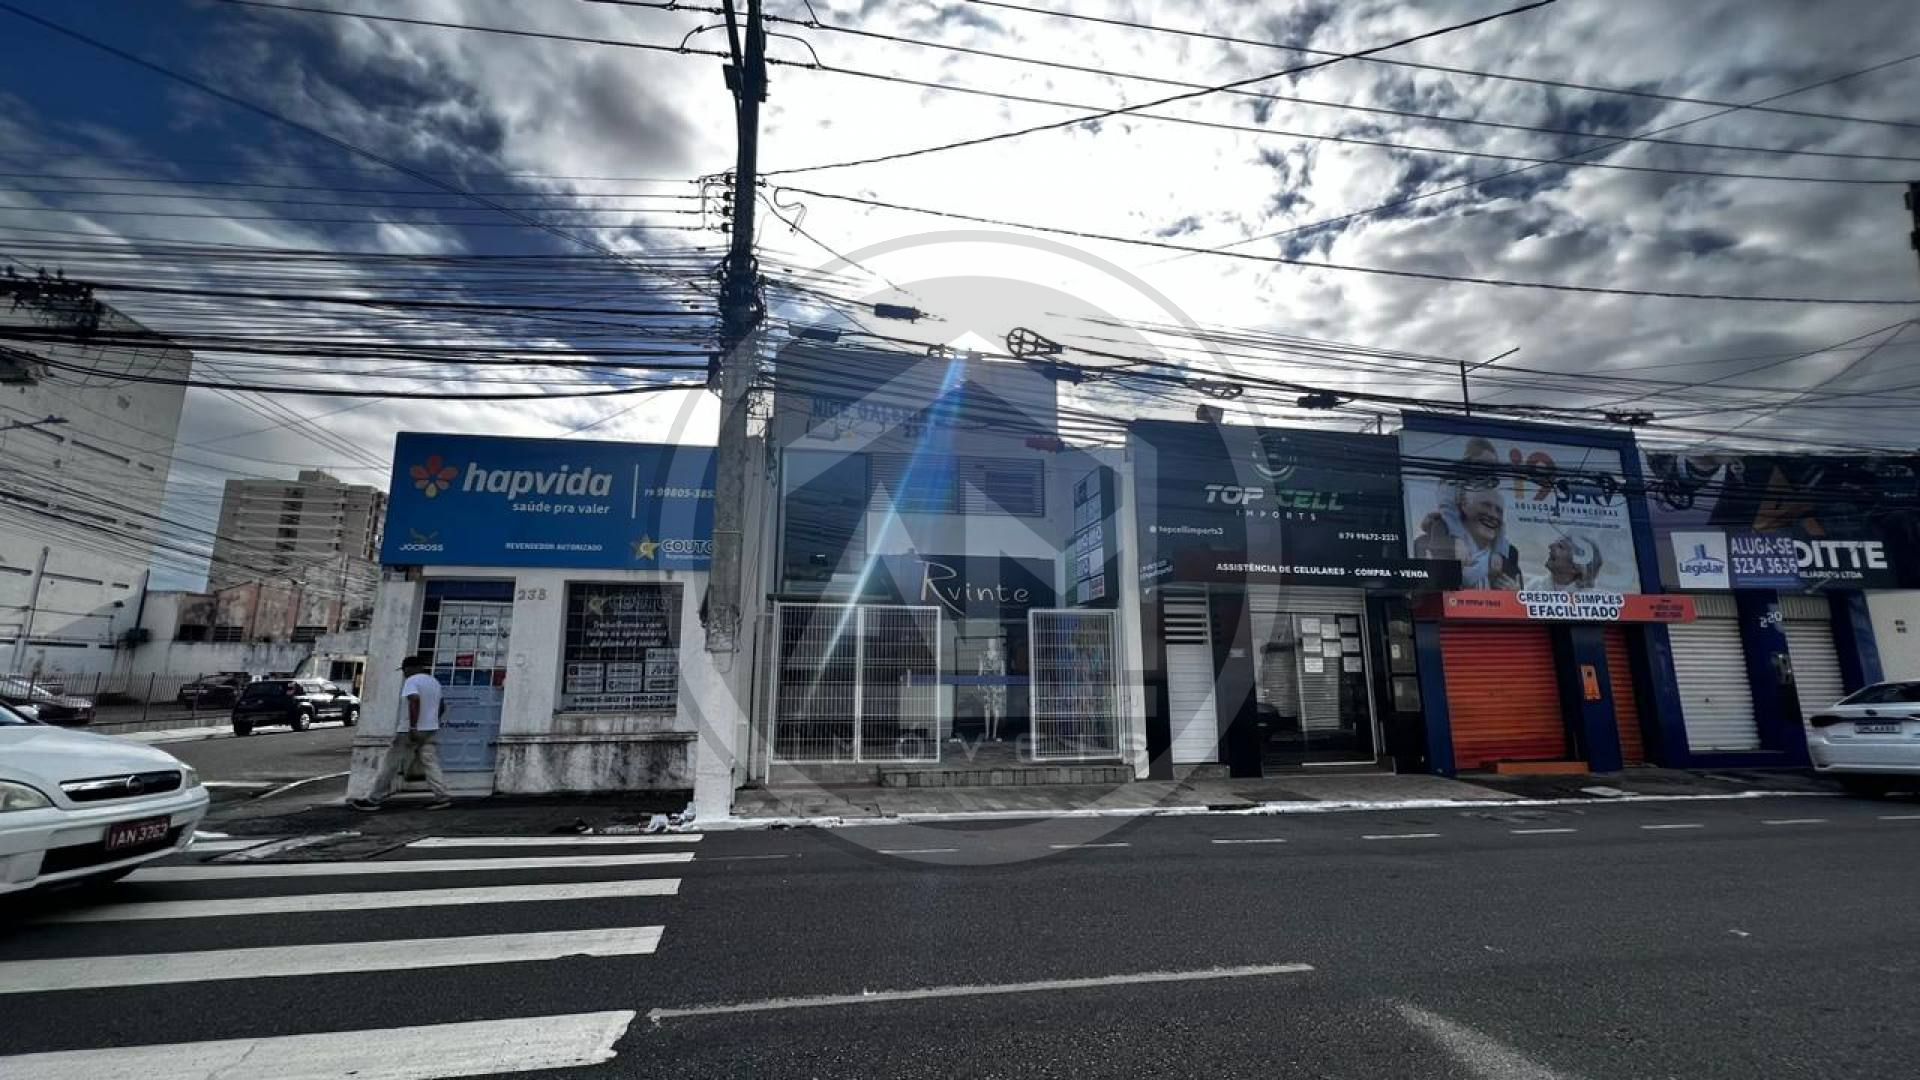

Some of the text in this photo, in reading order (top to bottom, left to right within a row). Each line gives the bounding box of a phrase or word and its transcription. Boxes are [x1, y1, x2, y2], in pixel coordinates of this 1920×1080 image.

[462, 462, 612, 501] hapvida
[1204, 484, 1345, 511] TOP CELL
[512, 502, 610, 515] saúde pra valer
[1235, 509, 1317, 521] IMPORTS
[1731, 537, 1793, 555] ALUGA-SE
[1216, 561, 1278, 574] ASSISTÊNCIA
[1279, 565, 1291, 574] DE
[1293, 566, 1345, 576] CELULARES
[1354, 568, 1392, 578] COMPRA
[1399, 569, 1430, 579] VENDA
[1732, 557, 1764, 574] 3234
[1574, 594, 1623, 605] SIMPLES
[1759, 611, 1783, 628] 220
